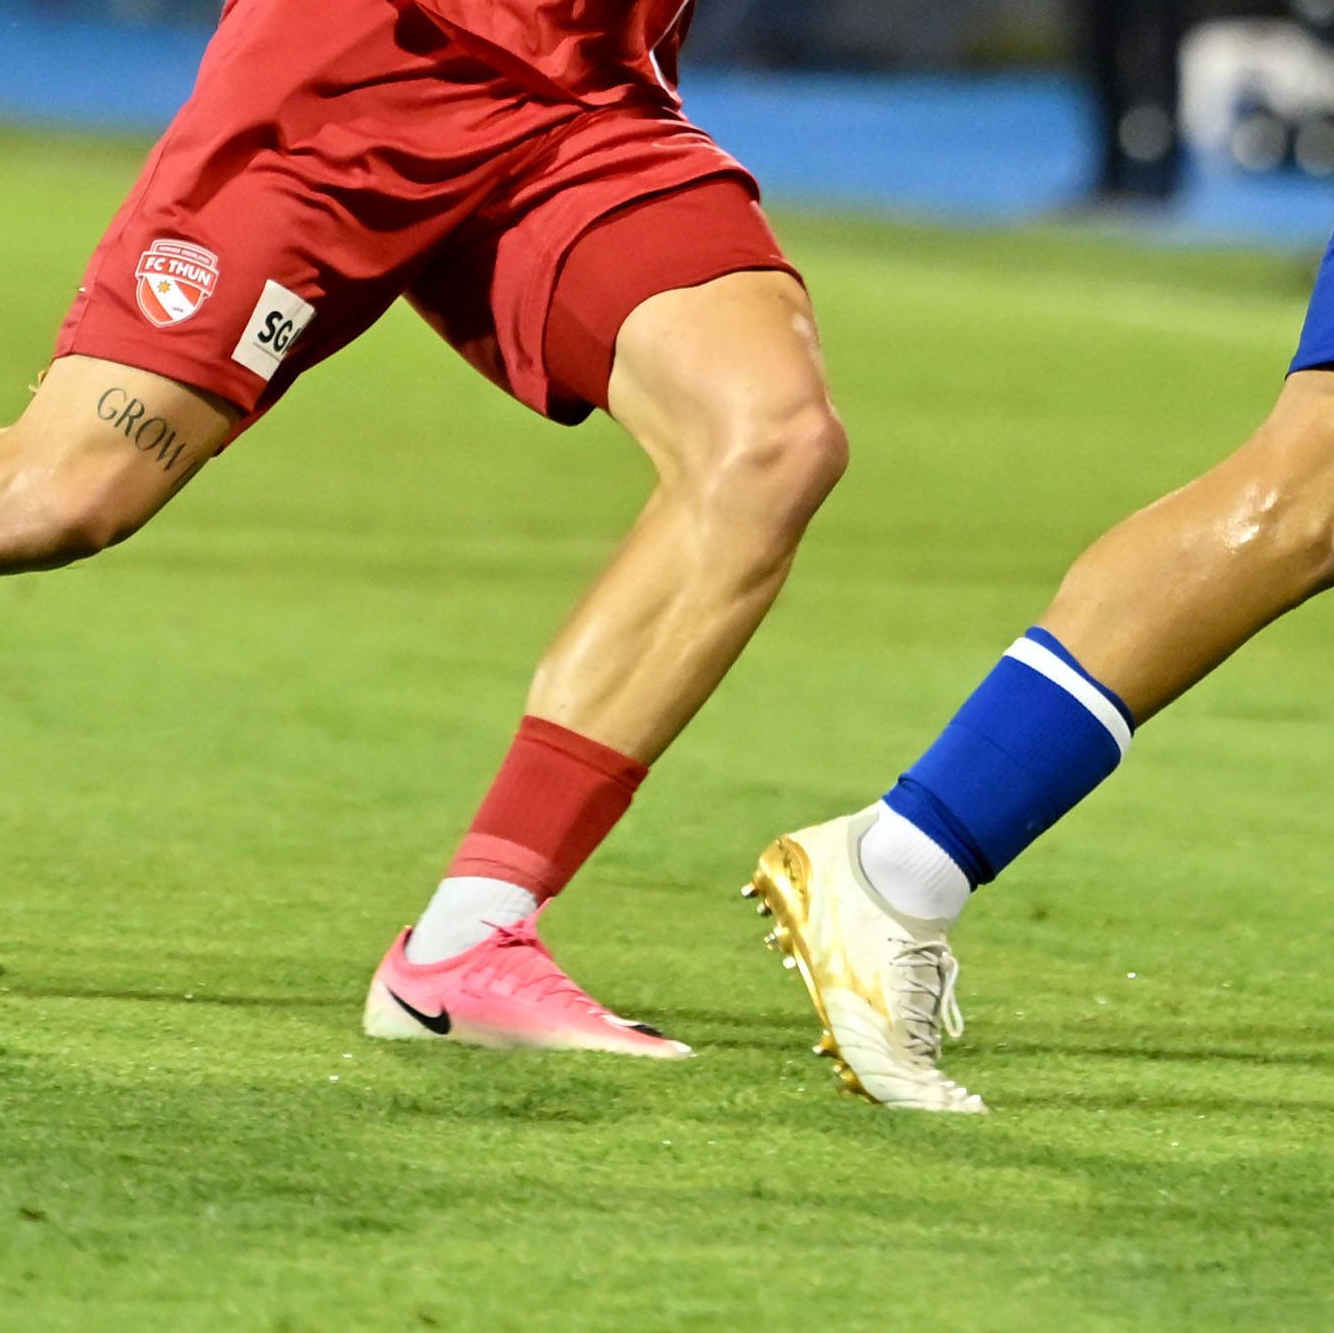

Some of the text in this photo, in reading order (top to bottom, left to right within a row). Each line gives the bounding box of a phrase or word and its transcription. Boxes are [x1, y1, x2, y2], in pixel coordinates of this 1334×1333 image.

[145, 257, 211, 287] FC THUN
[97, 387, 193, 472] GROW
